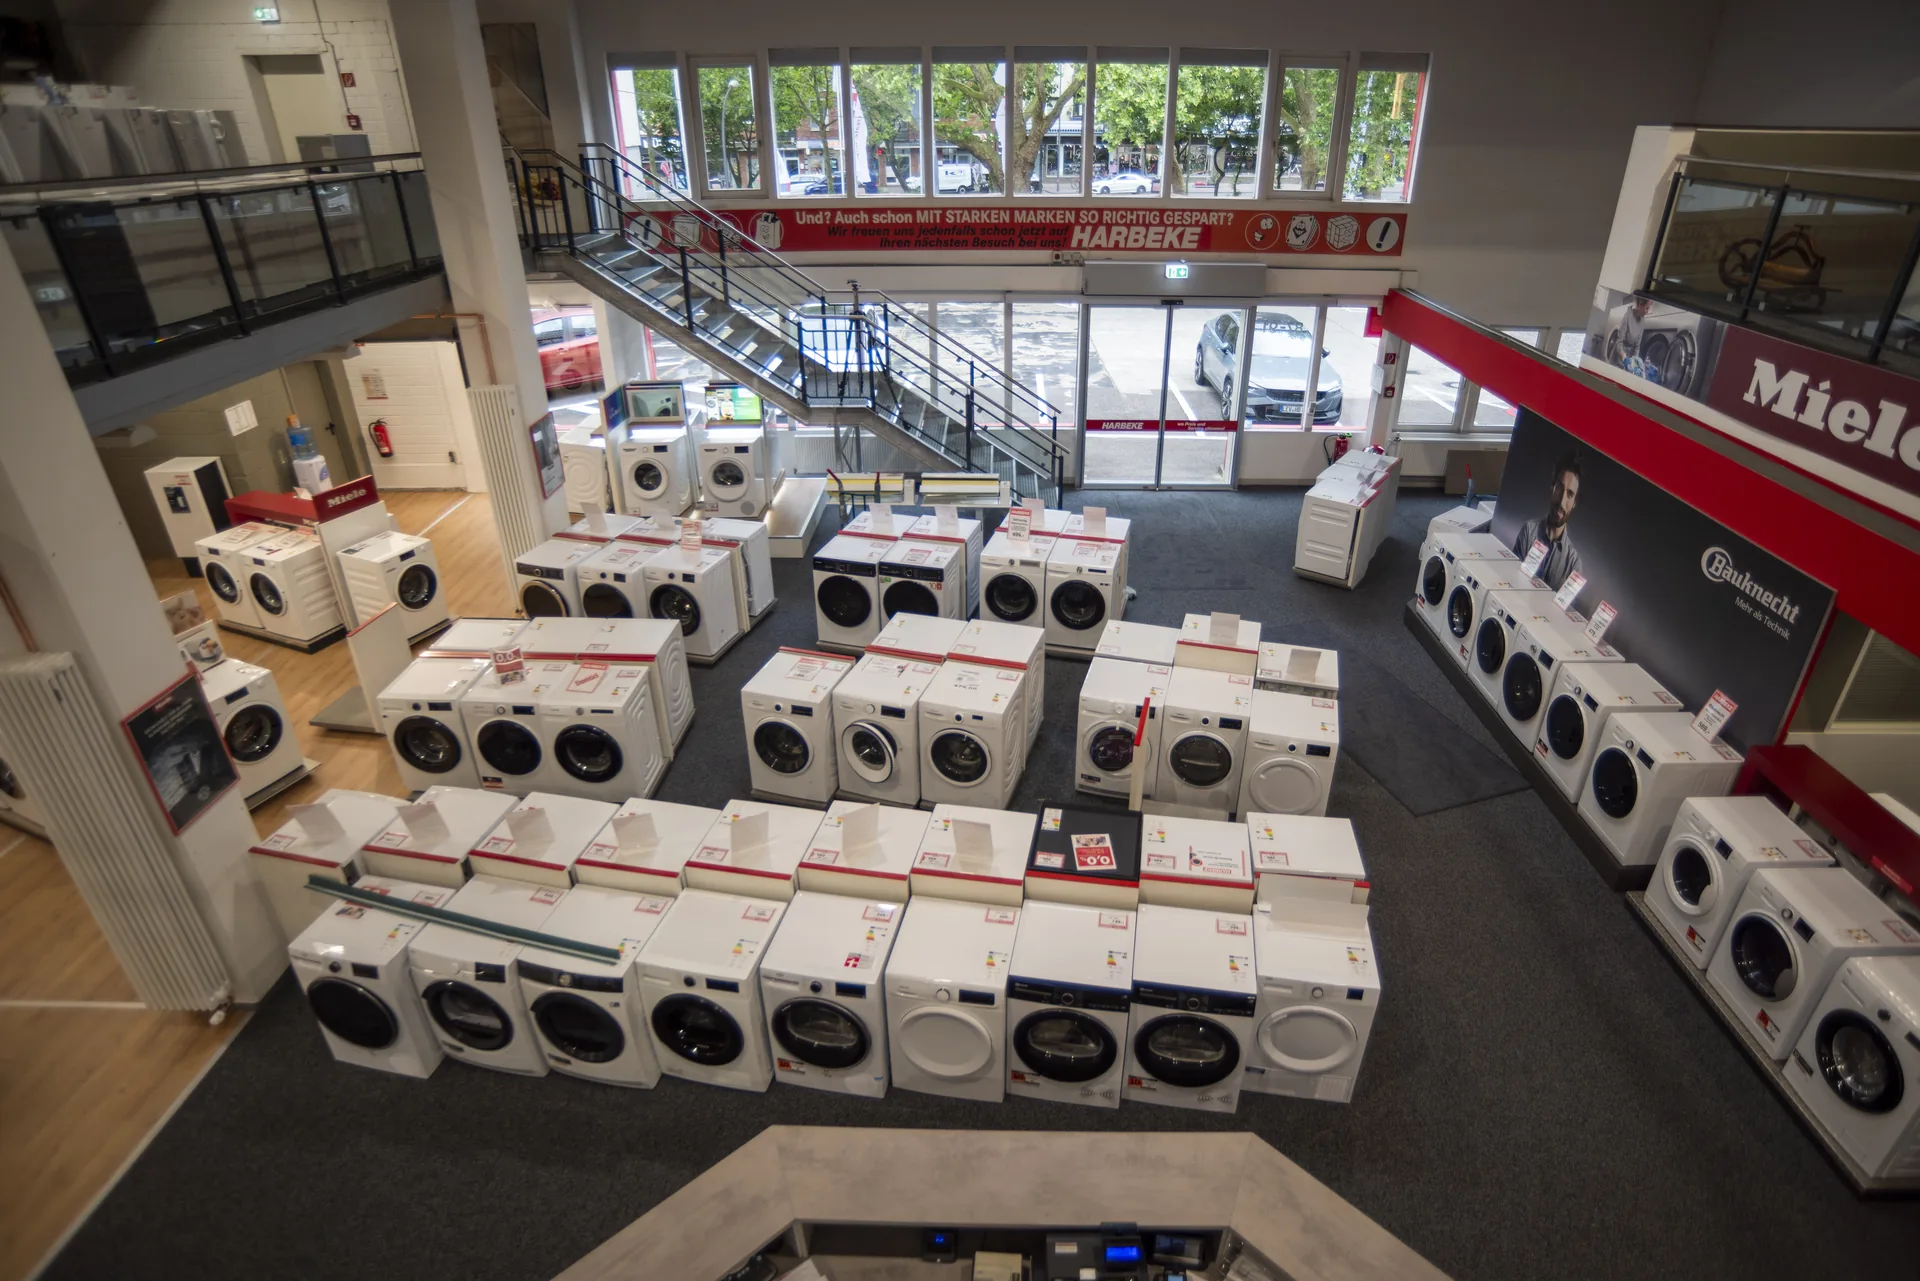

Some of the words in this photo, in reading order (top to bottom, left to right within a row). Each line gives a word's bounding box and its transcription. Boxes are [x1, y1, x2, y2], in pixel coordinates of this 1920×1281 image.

[796, 211, 831, 225] Und?
[835, 211, 869, 225] Auch
[872, 211, 913, 224] schon
[916, 210, 942, 223] MIT
[945, 210, 1010, 224] STARKEN
[1014, 210, 1076, 224] MARKEN
[1079, 210, 1099, 224] SO
[1102, 211, 1159, 224] RICHTIG
[1163, 211, 1235, 225] GESPART?
[827, 226, 847, 236] Wir
[851, 226, 890, 236] freuen
[893, 227, 914, 236] uns
[917, 225, 976, 237] jedenfalls
[980, 226, 1016, 236] schon
[1018, 226, 1046, 237] jetzt
[1050, 226, 1071, 236] auf
[1071, 226, 1202, 249] HARBEKE
[880, 238, 911, 248] Ihren
[914, 237, 968, 248] nächsten
[972, 237, 1015, 247] Besuch
[1018, 237, 1036, 247] bei
[1040, 238, 1067, 247] uns!
[1102, 421, 1144, 430] HARBEKE
[327, 488, 367, 509] Miele
[1702, 547, 1800, 624] Bauknecht
[1735, 596, 1753, 616] Mehr
[1753, 611, 1763, 621] als
[1763, 615, 1791, 640] Technik
